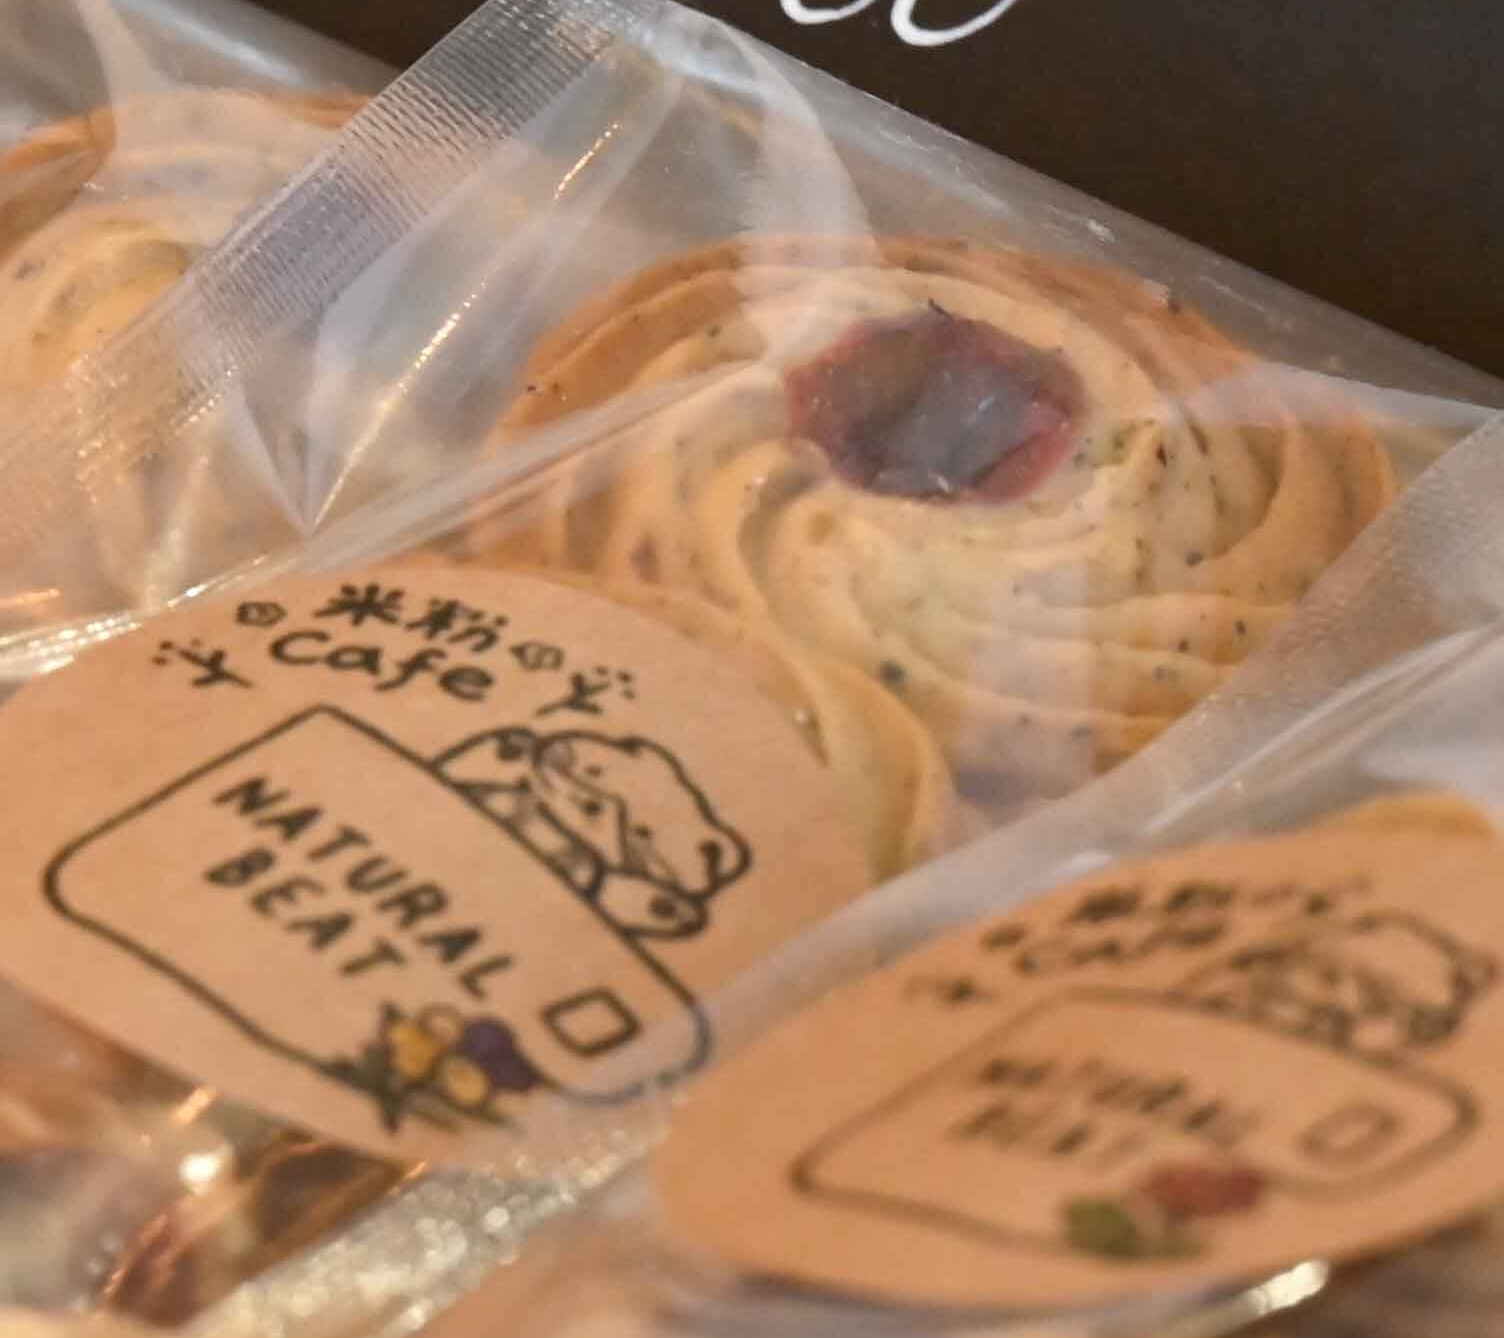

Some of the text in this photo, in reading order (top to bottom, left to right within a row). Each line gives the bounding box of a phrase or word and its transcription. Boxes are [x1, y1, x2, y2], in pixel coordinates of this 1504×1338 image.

[268, 628, 496, 705] Cafe
[312, 582, 510, 656] 米粉
[202, 845, 406, 986] BEAT
[210, 775, 516, 1002] NATURAL
